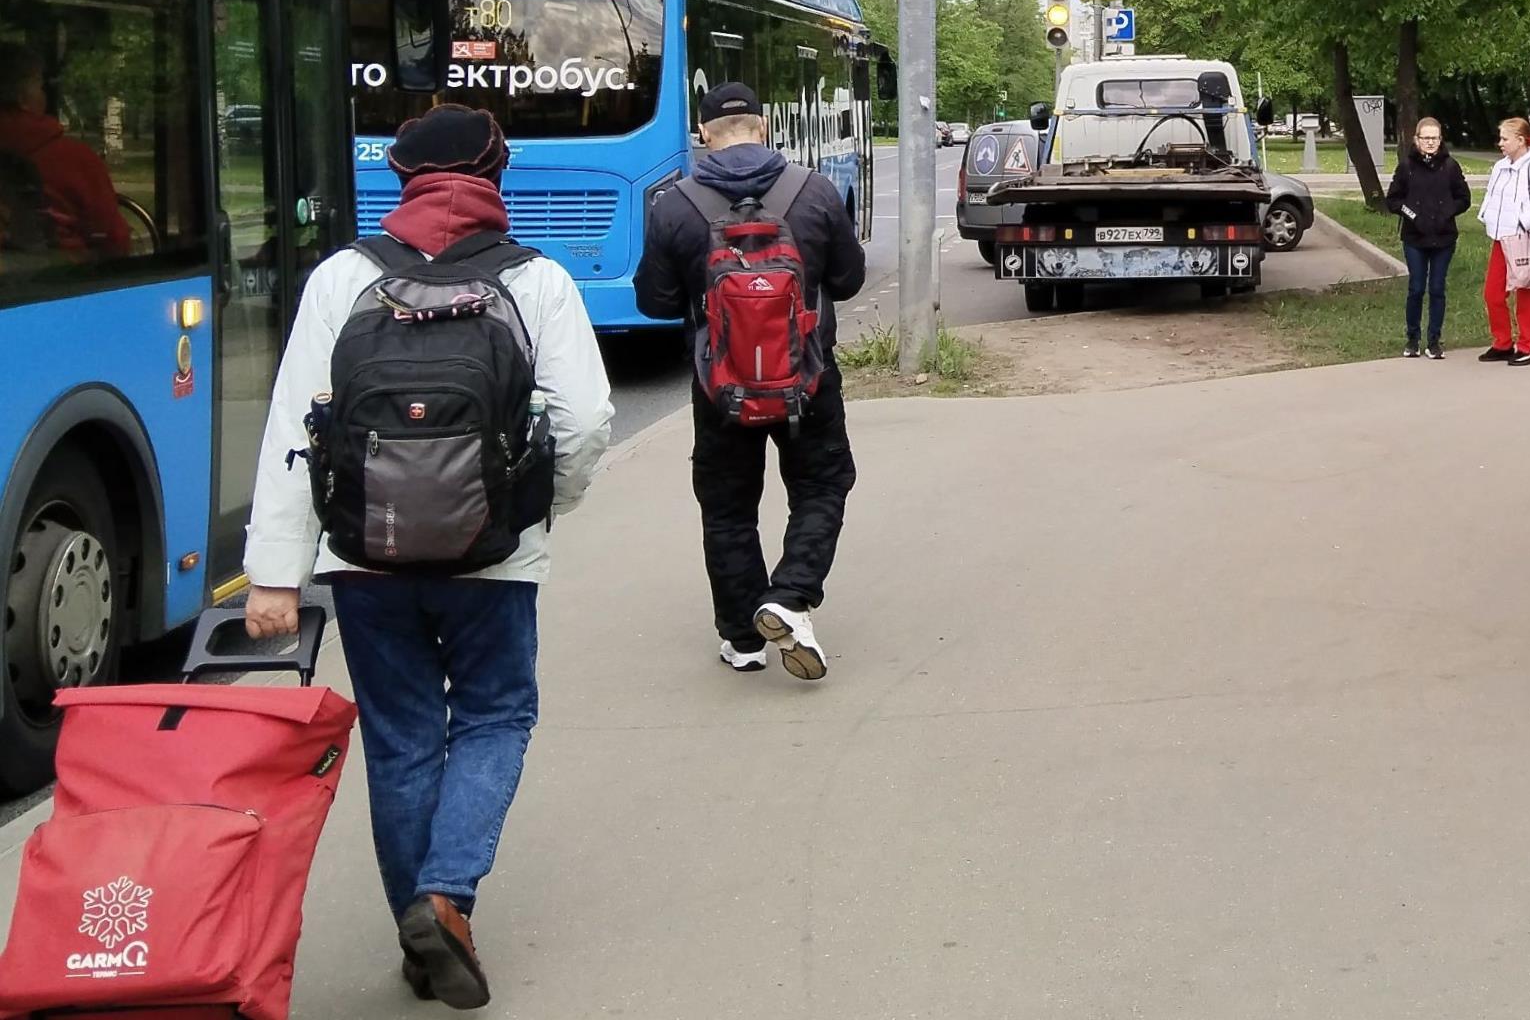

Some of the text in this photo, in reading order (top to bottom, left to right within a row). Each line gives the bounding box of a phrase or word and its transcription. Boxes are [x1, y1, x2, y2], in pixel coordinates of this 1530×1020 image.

[351, 57, 635, 97] то ектробус.
[354, 142, 389, 161] 25
